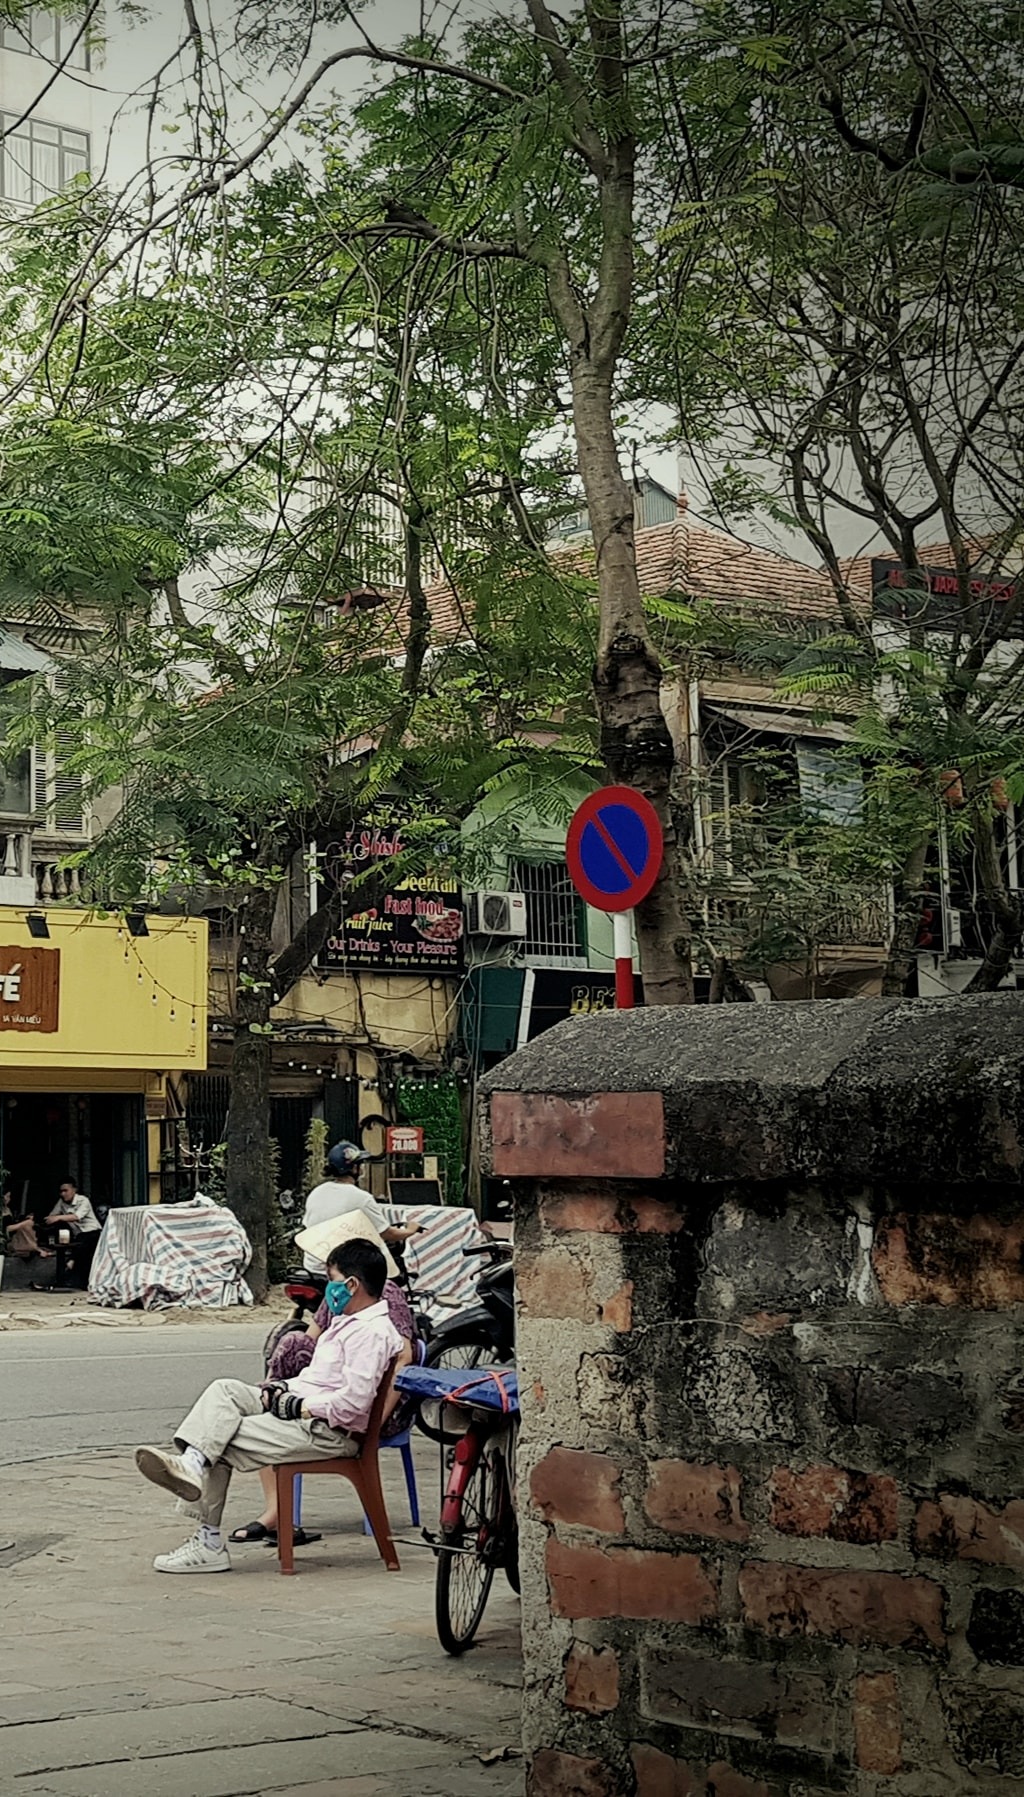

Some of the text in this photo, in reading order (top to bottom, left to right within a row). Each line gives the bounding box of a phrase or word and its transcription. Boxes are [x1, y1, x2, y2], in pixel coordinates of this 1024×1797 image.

[349, 938, 380, 953] Drinks
[390, 940, 414, 954] Your
[417, 941, 457, 955] Pleasure
